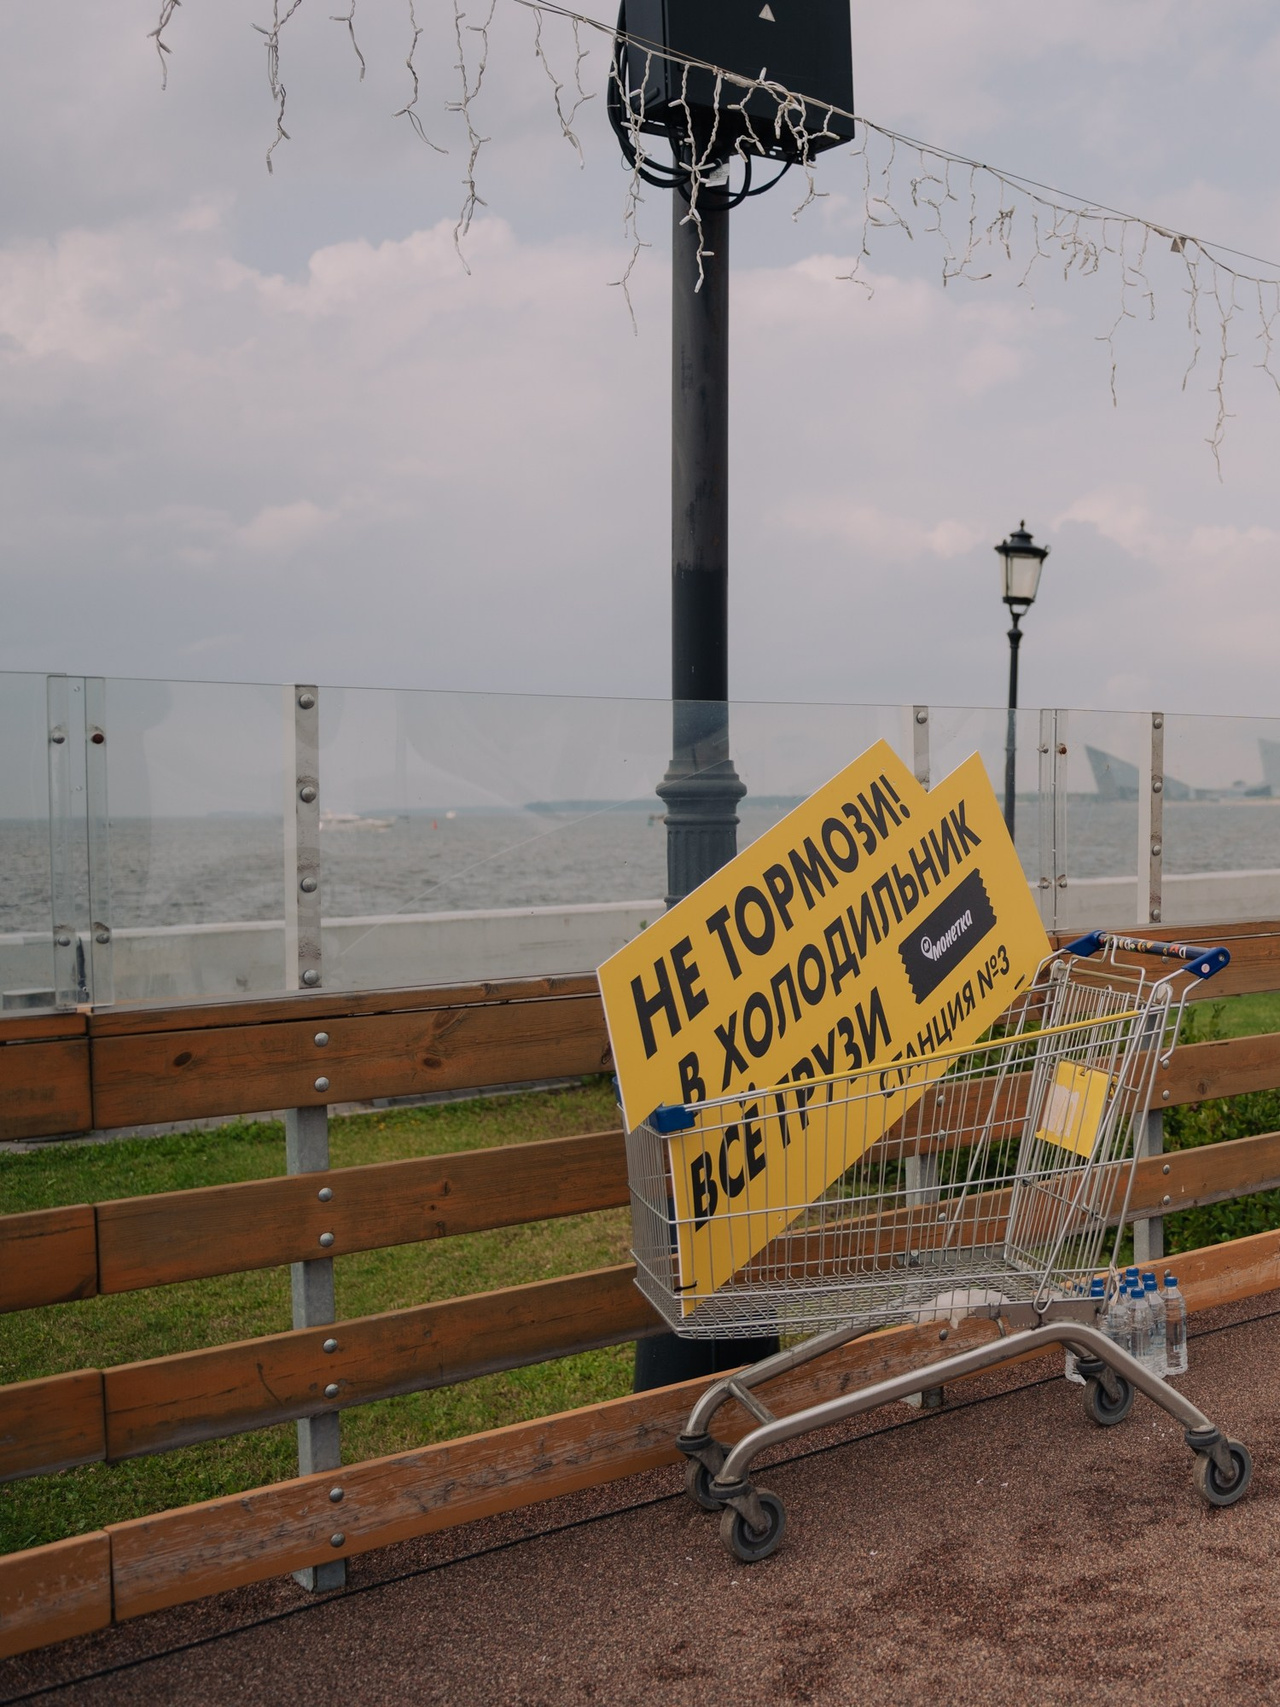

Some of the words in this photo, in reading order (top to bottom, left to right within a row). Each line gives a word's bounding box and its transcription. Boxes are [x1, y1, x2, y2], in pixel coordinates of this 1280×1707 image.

[630, 935, 709, 1060] НЕ
[705, 774, 911, 980] ТОРМОЗИ!
[678, 1051, 706, 1119] В
[714, 800, 982, 1092] ХОЛОДИЛЬНИК
[879, 980, 976, 1098] СТАНЦИЯ
[976, 944, 1010, 999] №3
[690, 1082, 767, 1232] ВСЁ
[774, 986, 892, 1149] ГРУЗИ
